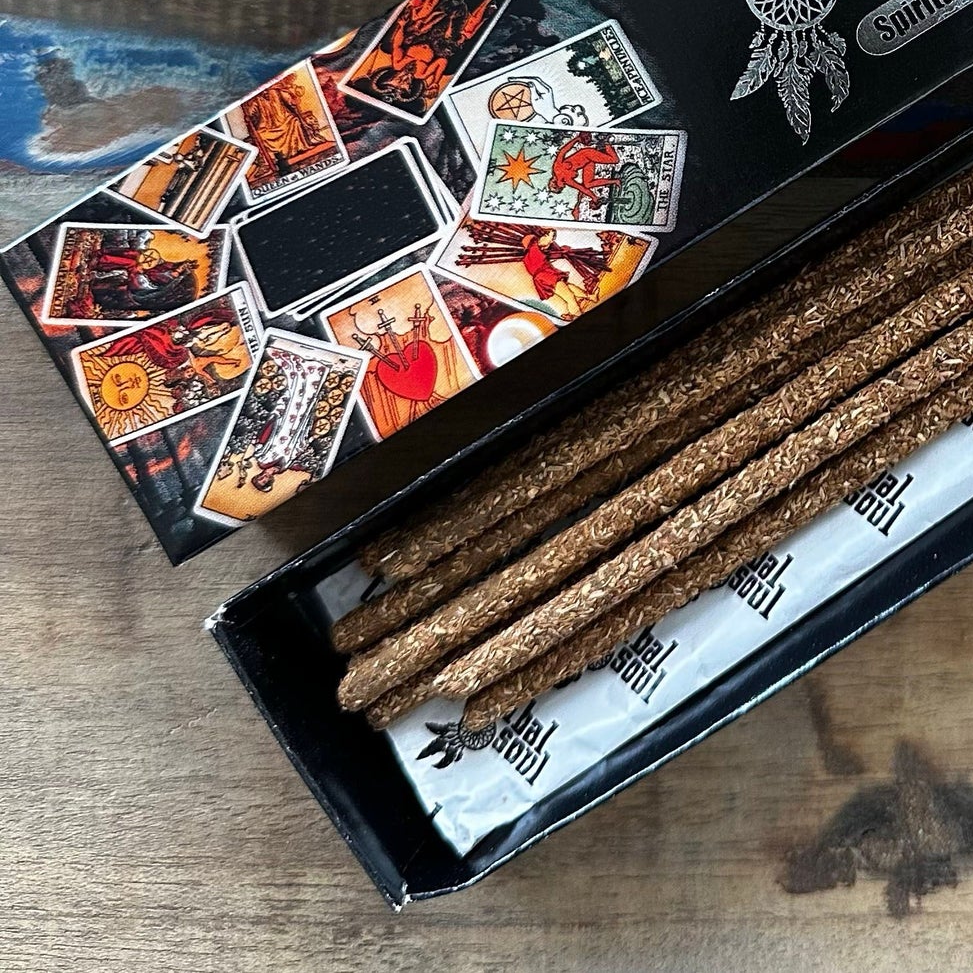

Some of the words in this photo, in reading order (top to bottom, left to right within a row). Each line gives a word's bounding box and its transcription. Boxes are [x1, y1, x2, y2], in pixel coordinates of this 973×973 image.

[600, 25, 638, 81] PENTACLES
[253, 176, 290, 196] QUEEN
[656, 187, 669, 213] THE
[727, 565, 787, 621] soul
[610, 646, 668, 705] soul
[491, 726, 552, 787] soul
